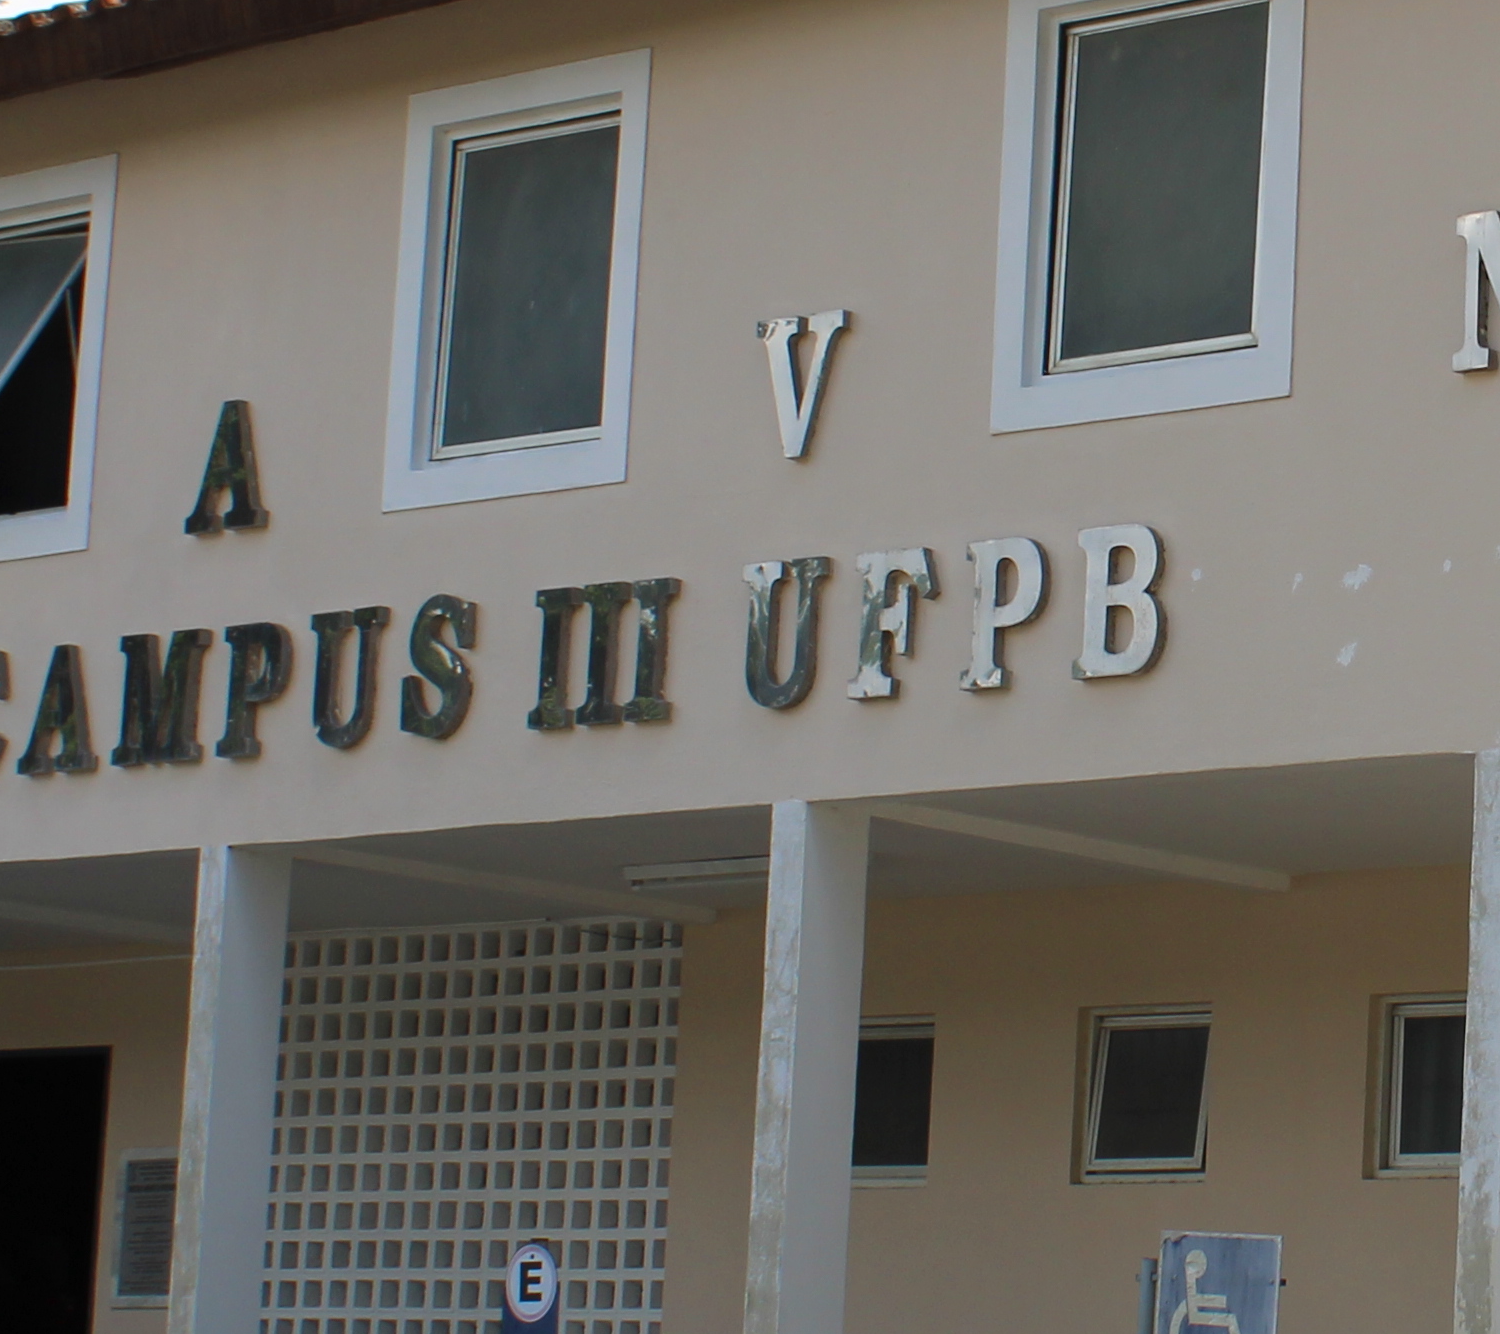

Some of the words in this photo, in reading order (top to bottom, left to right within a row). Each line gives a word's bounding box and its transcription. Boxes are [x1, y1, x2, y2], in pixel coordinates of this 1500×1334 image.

[183, 398, 270, 537] A
[756, 309, 851, 460] V
[527, 577, 682, 733] III
[742, 523, 1168, 710] UFPB
[519, 1261, 543, 1302] E
